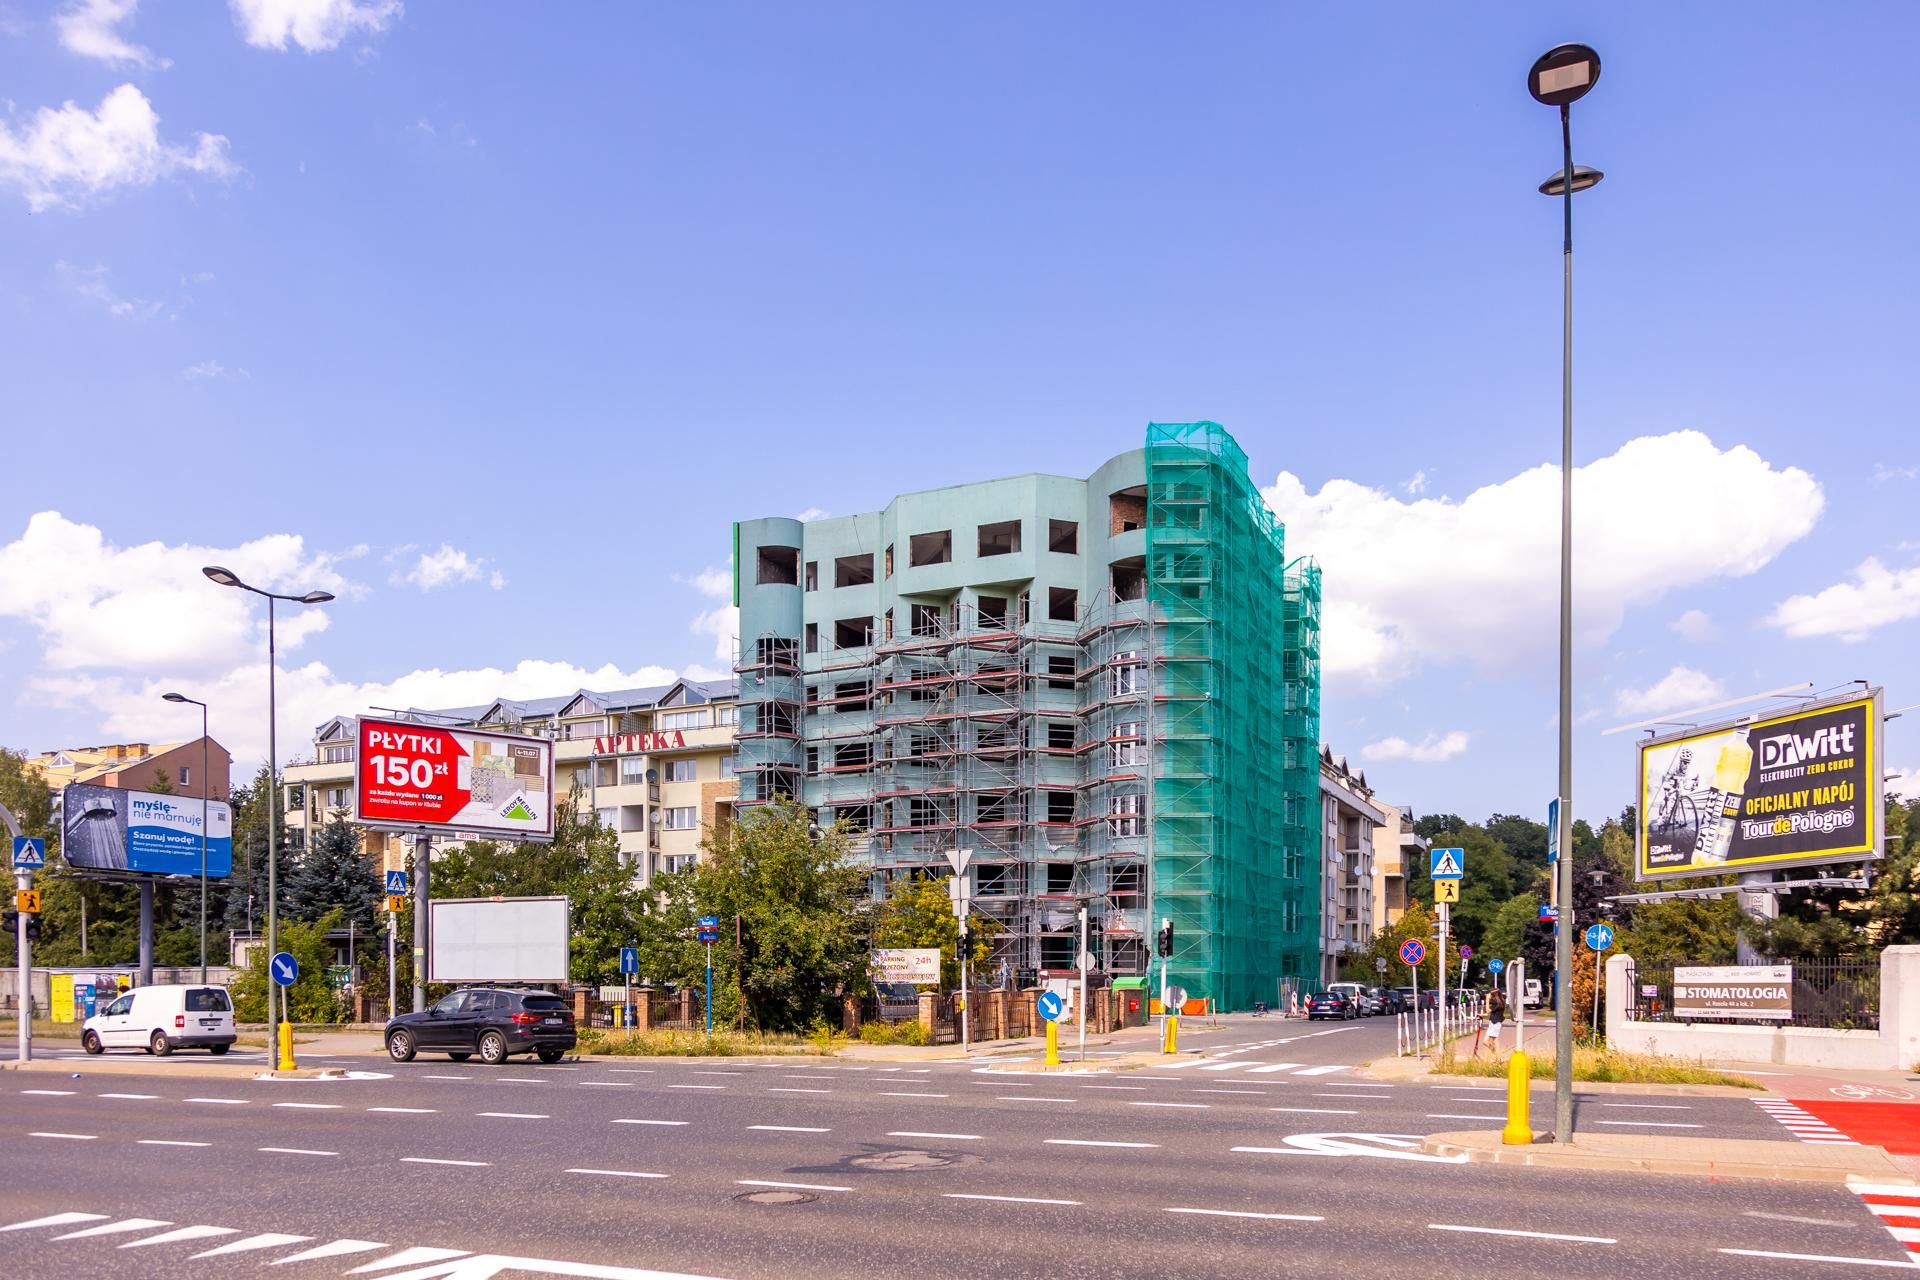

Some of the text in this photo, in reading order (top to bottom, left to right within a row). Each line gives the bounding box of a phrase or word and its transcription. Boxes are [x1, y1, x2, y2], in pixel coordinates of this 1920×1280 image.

[369, 730, 442, 755] PŁYTKI
[592, 730, 687, 755] APTEKA
[1760, 723, 1854, 769] DrWitt
[370, 755, 449, 788] 150 zł
[1760, 758, 1854, 783] ELEKTROLITY ZERO CUKRU
[396, 791, 419, 799] wydane
[399, 799, 417, 807] kupon
[424, 801, 442, 809] Klubie
[1746, 781, 1854, 816] OFICJALNY NAPÓJ
[133, 810, 202, 827] nie marnuję
[499, 796, 539, 820] LEROY MERLIN
[1742, 810, 1853, 840] TourdePologne
[133, 831, 194, 845] Szanuj wodę!
[915, 956, 932, 965] 24h
[1687, 987, 1788, 999] STOMATOLOGIA
